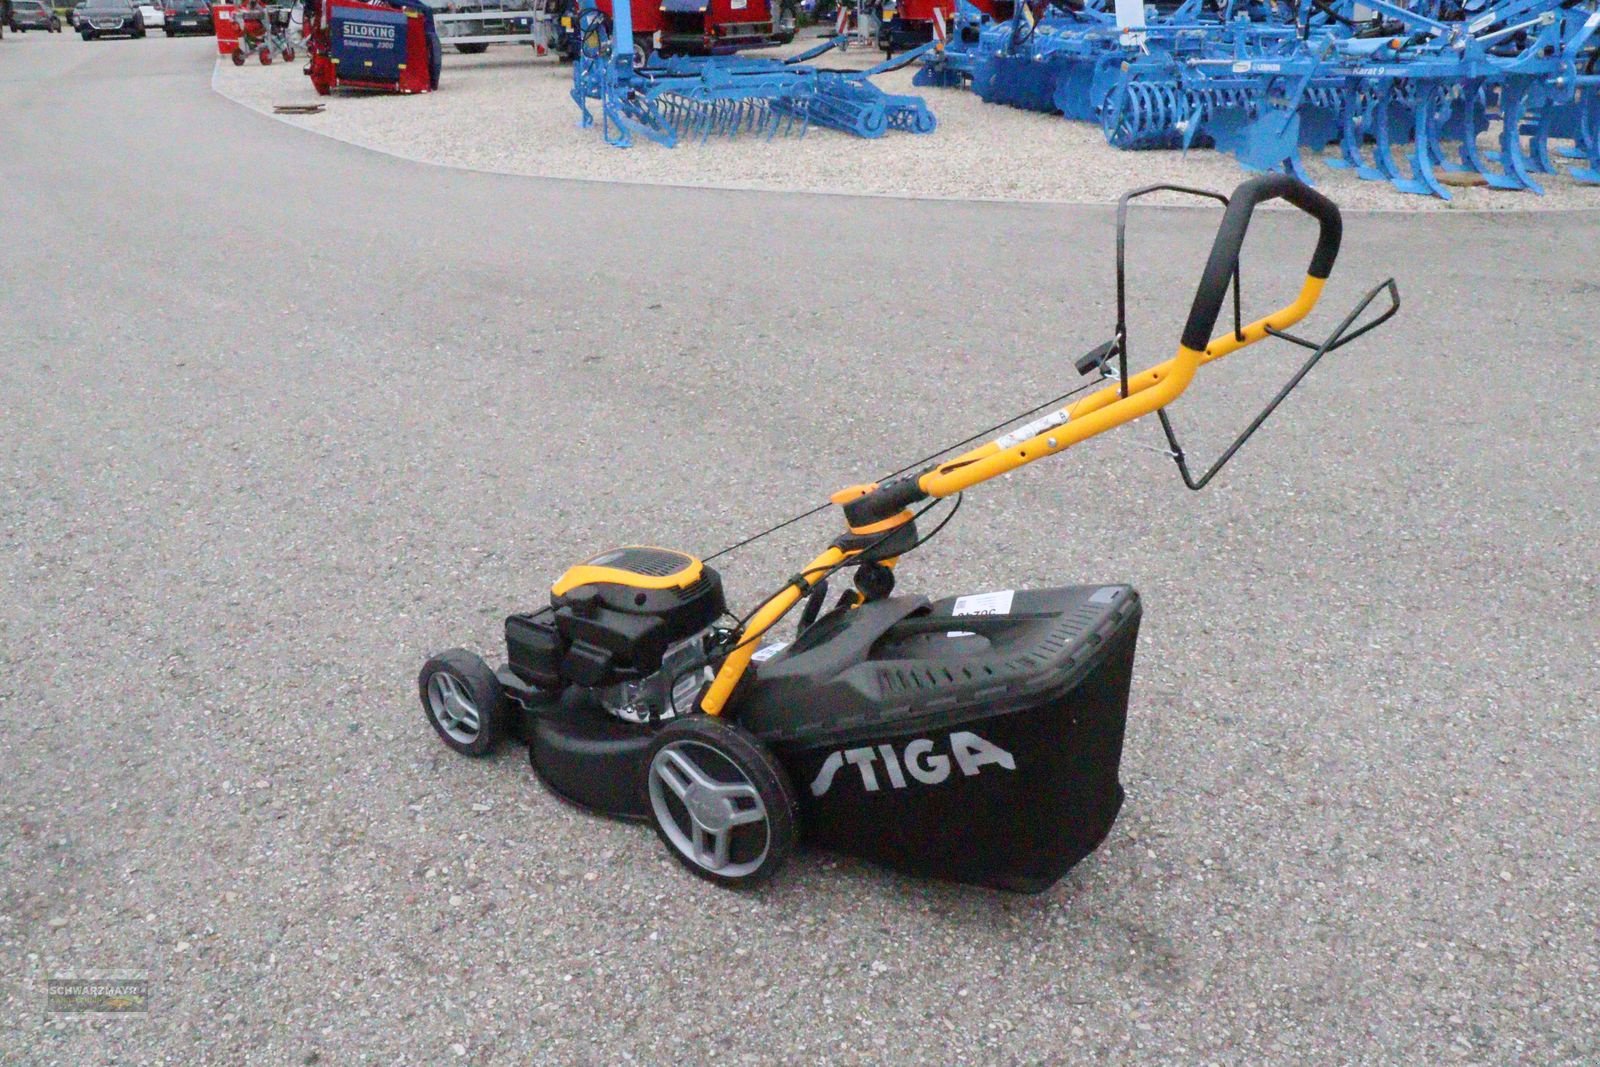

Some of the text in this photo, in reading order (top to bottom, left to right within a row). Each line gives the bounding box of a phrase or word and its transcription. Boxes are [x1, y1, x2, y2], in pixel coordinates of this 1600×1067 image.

[343, 24, 395, 38] SILOKING
[1352, 66, 1377, 75] Karat
[1378, 66, 1385, 75] 9
[809, 731, 1017, 797] STIGA
